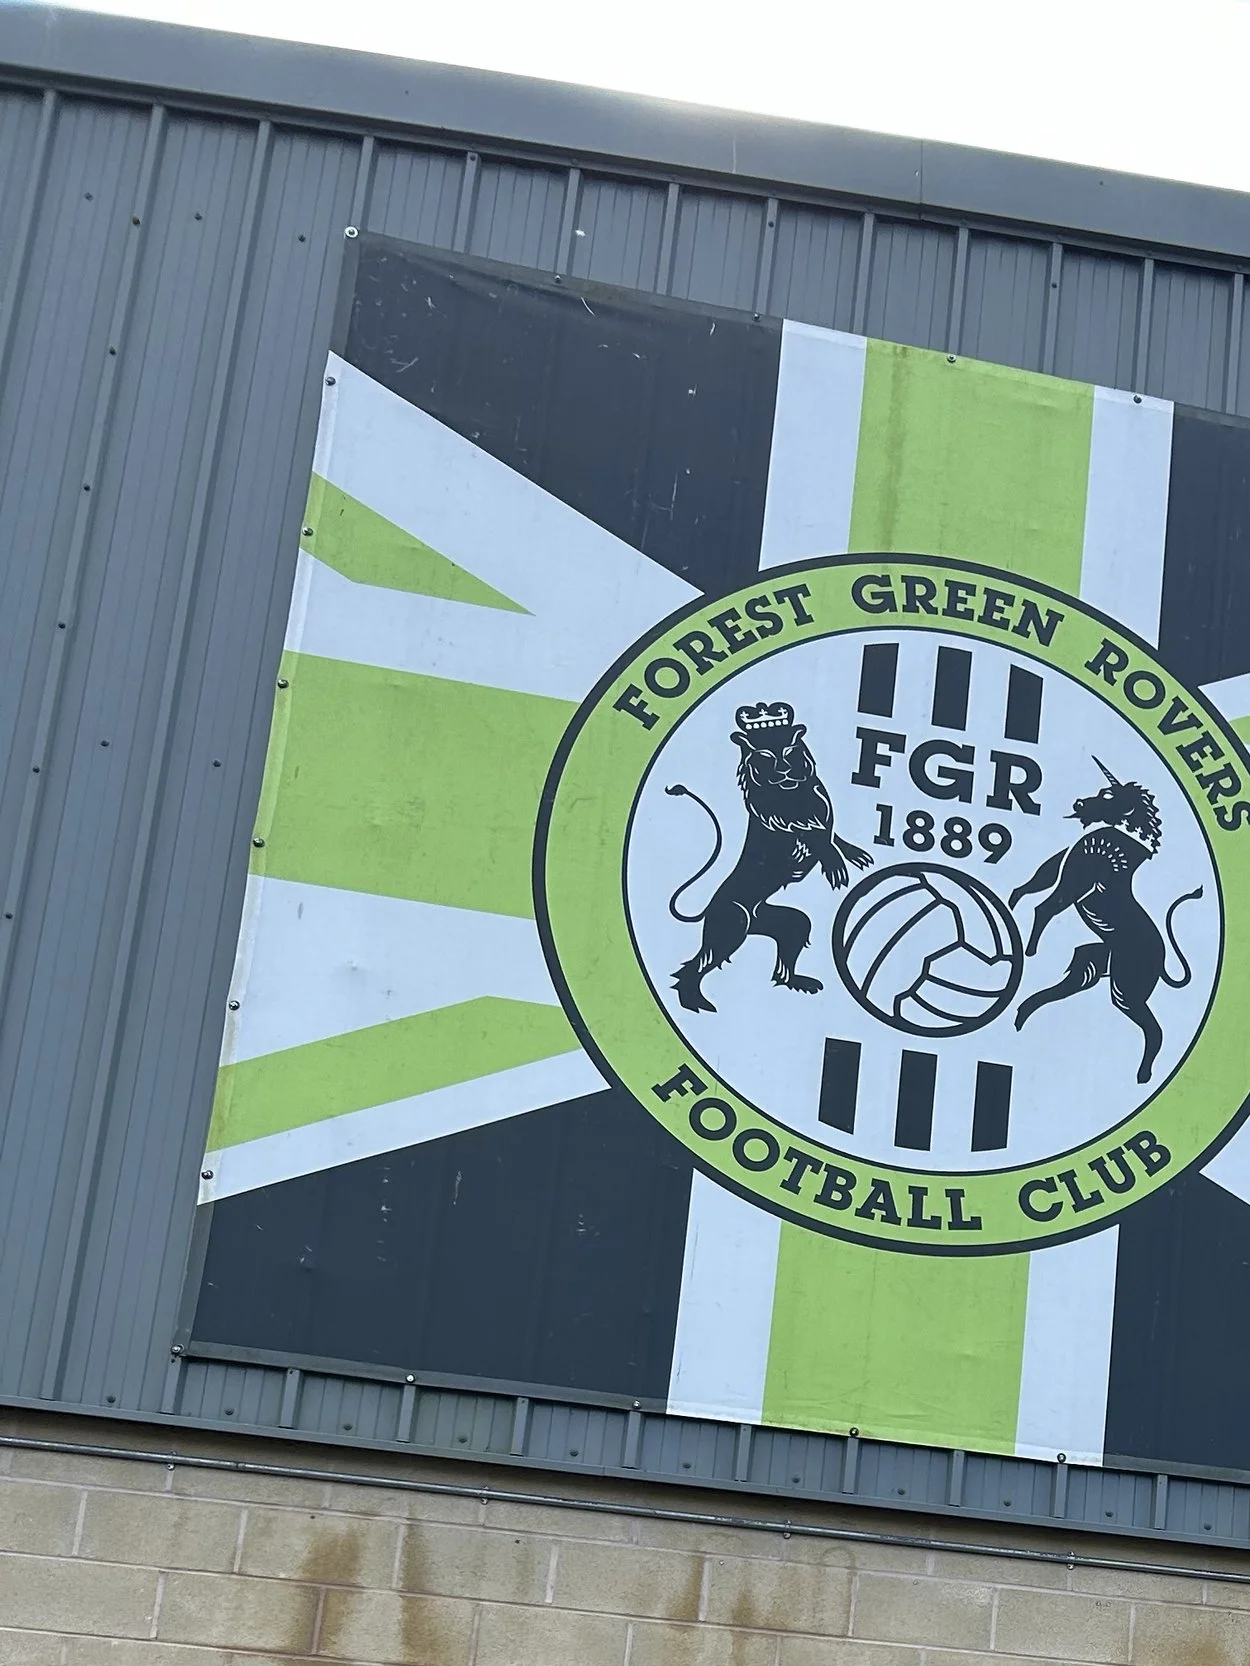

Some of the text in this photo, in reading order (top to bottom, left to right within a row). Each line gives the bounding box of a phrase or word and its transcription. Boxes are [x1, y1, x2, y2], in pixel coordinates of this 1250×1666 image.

[613, 584, 815, 731] FOREST
[851, 574, 1064, 647] GREEN
[851, 726, 1043, 816] FGR
[873, 803, 1012, 864] 1889
[652, 1064, 1171, 1231] FOOTBALL CLUB
